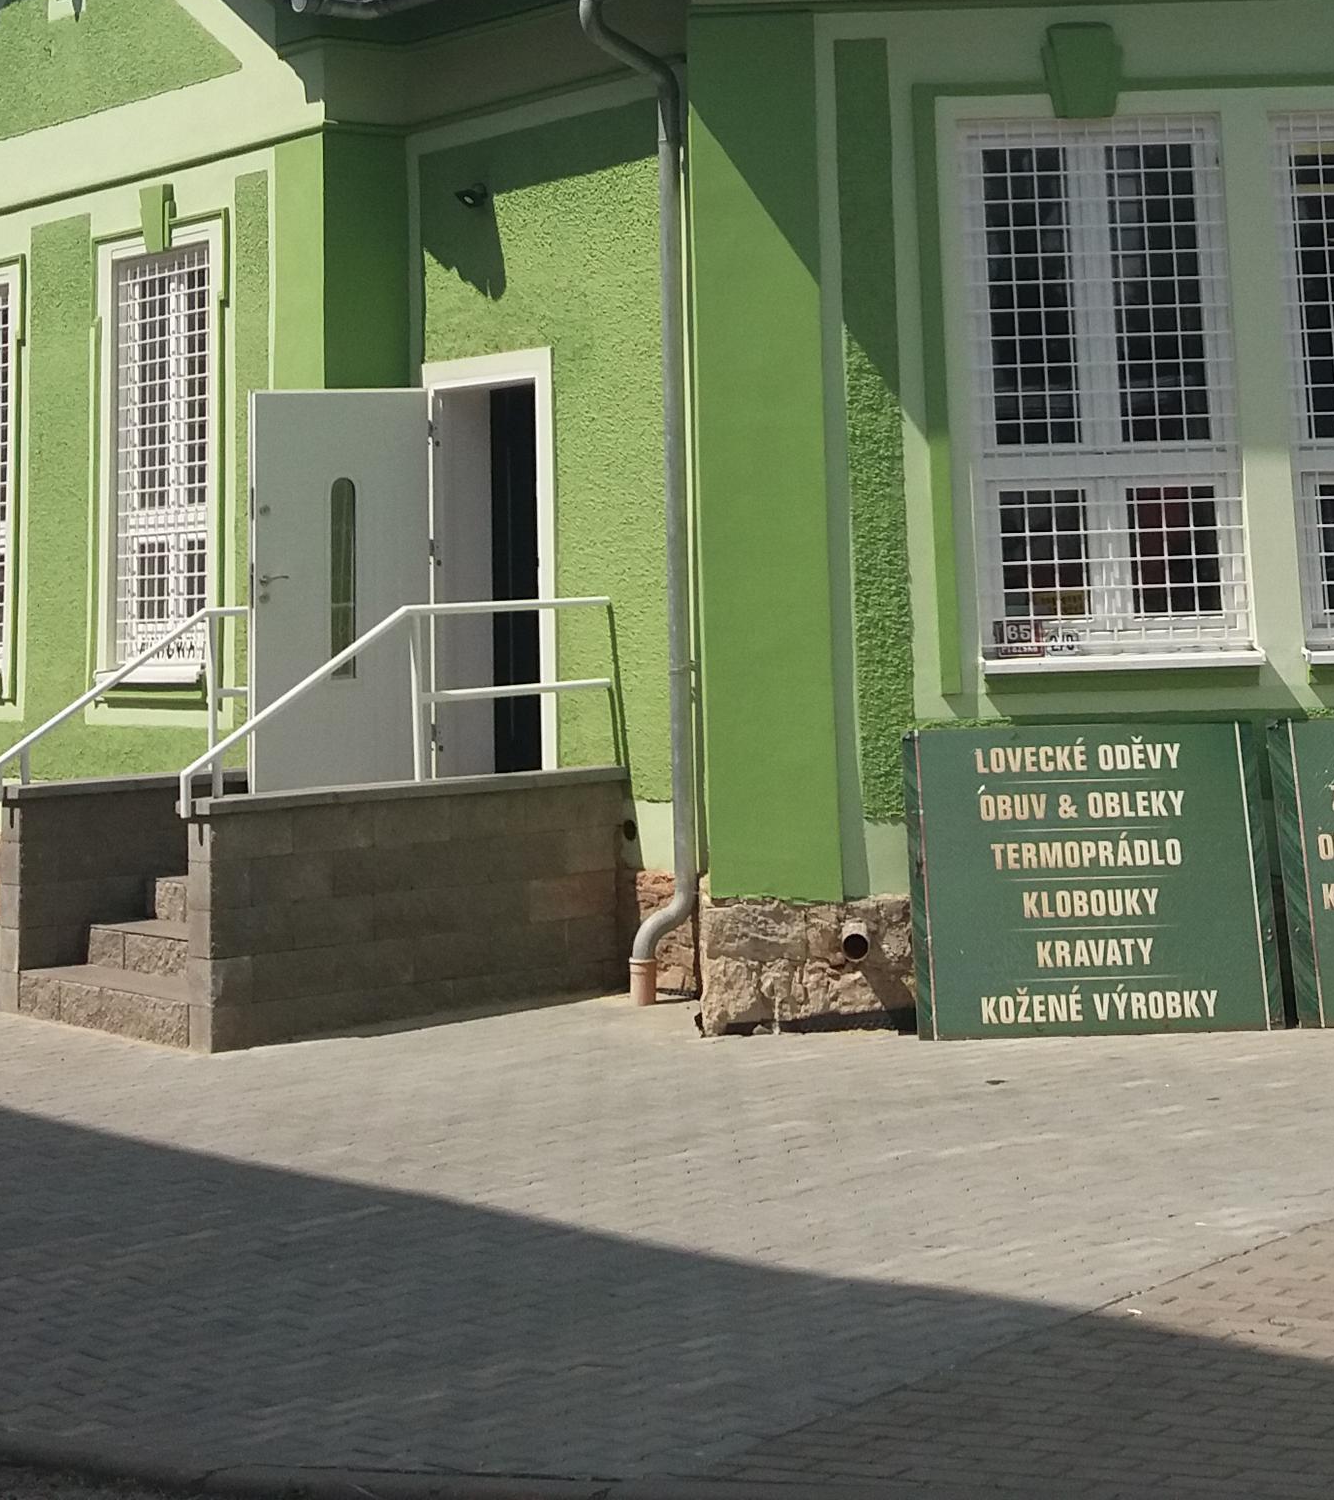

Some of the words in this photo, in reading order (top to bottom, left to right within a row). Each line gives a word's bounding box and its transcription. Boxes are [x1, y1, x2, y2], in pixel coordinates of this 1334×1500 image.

[1006, 624, 1032, 640] 65
[975, 737, 1088, 774] LOVECKÉ
[1097, 736, 1181, 771] ODĚVY
[979, 793, 1047, 821] OBUV
[1058, 794, 1078, 819] &
[1087, 790, 1185, 819] OBLEKY
[990, 831, 1182, 870] TERMOPRÁDLO
[1022, 888, 1159, 918] KLOBOUKY
[1036, 938, 1154, 968] KRAVATY
[980, 986, 1083, 1024] KOŽENÉ
[1093, 984, 1218, 1021] VÝROBKY
